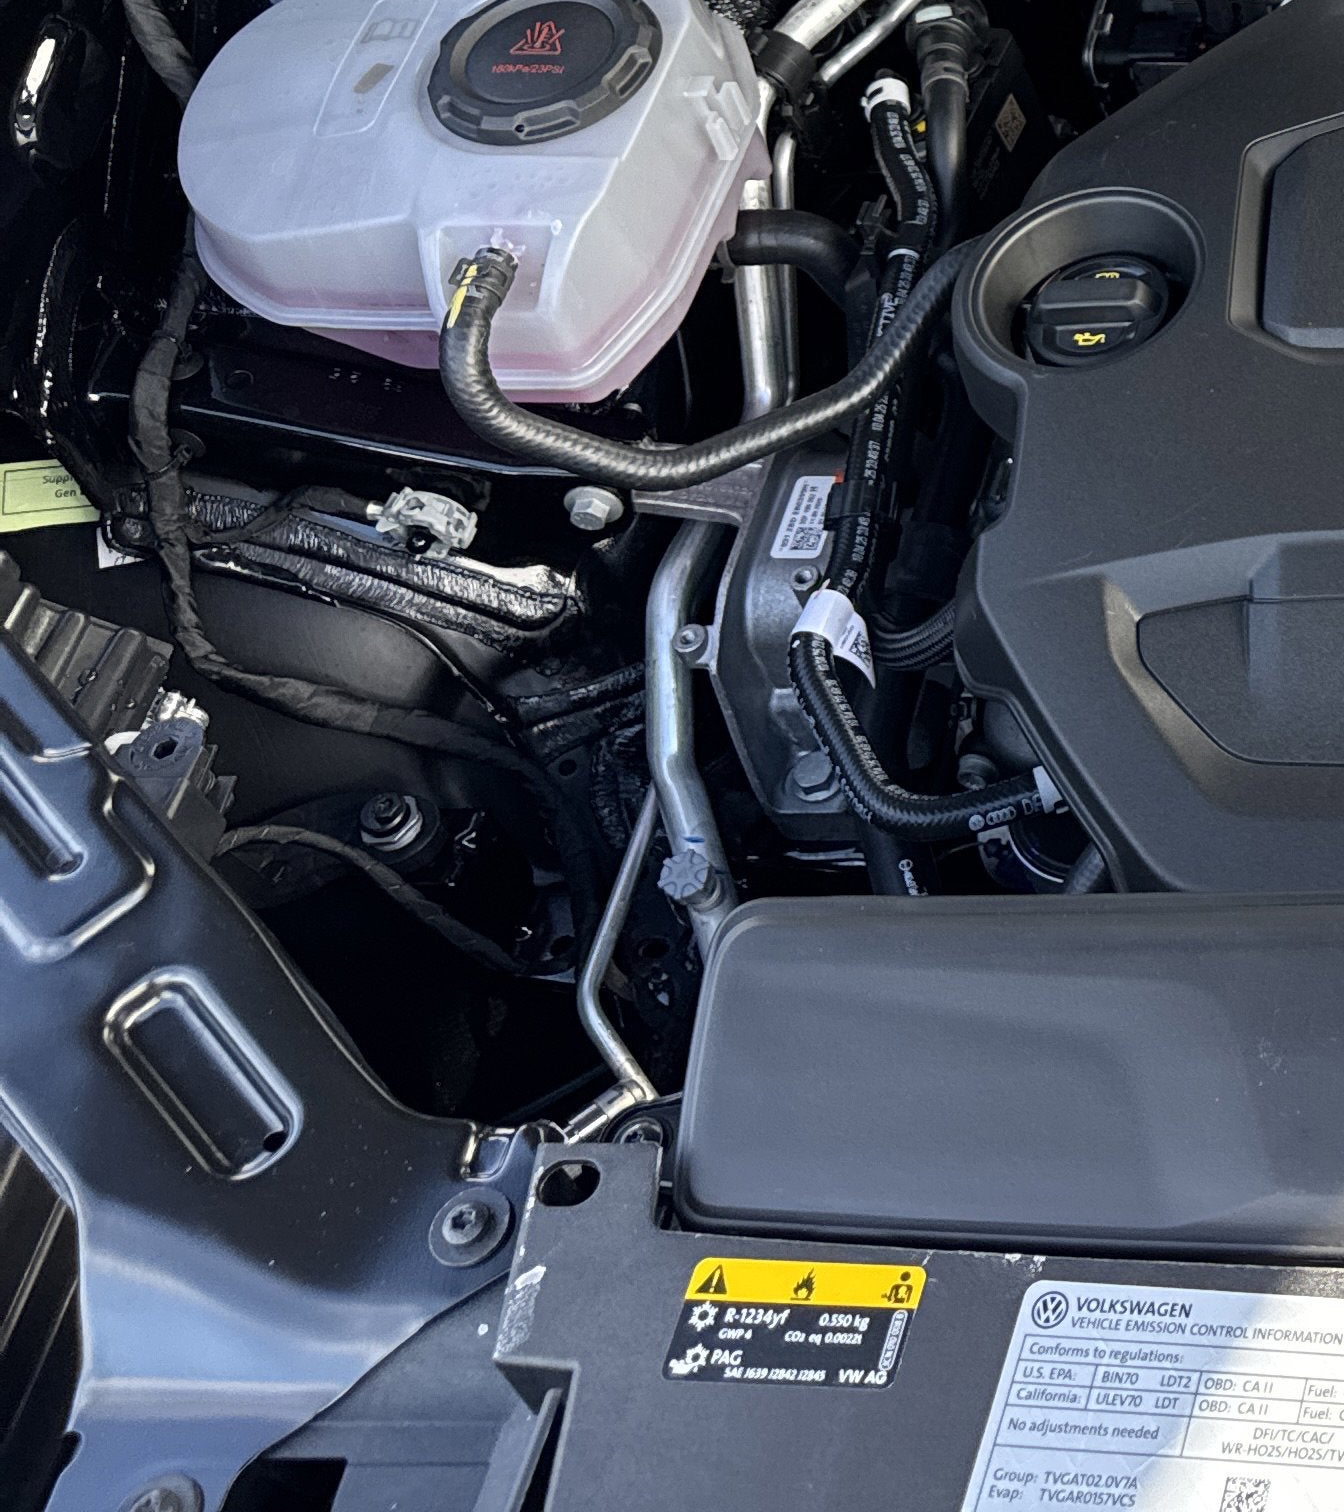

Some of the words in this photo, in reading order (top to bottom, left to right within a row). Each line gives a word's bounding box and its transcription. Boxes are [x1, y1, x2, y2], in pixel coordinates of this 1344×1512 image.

[1077, 1297, 1192, 1318] VOLKSWAGEN
[724, 1308, 791, 1328] R-1234yf
[819, 1313, 853, 1328] 0.550
[853, 1315, 871, 1330] kg
[718, 1328, 743, 1340] GWP
[1071, 1316, 1120, 1331] VEHICLE
[1125, 1319, 1186, 1335] EMISSION
[1190, 1323, 1248, 1339] CONTROL
[1252, 1328, 1343, 1345] INFORMATION
[710, 1349, 744, 1365] PAG
[1029, 1342, 1090, 1358] Conforms
[1094, 1345, 1106, 1359] to
[1109, 1345, 1183, 1363] regulations:
[724, 1367, 745, 1379] SAE
[838, 1369, 865, 1384] VW
[865, 1369, 888, 1385] AG
[1023, 1366, 1045, 1379] U.S.
[1049, 1367, 1075, 1381] EPA:
[1101, 1371, 1139, 1384] BIN70
[1160, 1375, 1192, 1388] LDT2
[1204, 1377, 1236, 1392] OBD:
[1242, 1380, 1260, 1393] CA
[1307, 1384, 1337, 1398] Fuel:
[1016, 1387, 1081, 1404] California:
[1095, 1392, 1143, 1407] ULEV70
[1154, 1395, 1180, 1409] LDT
[1199, 1399, 1231, 1412] OBD:
[1237, 1402, 1256, 1415] CA
[1303, 1407, 1332, 1420] Fuel:
[1007, 1416, 1026, 1431] No
[1029, 1418, 1109, 1436] adjustments
[1112, 1424, 1160, 1440] needed
[1253, 1427, 1335, 1444] DFI/TC/CAC/
[993, 1468, 1038, 1486] Group:
[988, 1485, 1023, 1502] Evap:
